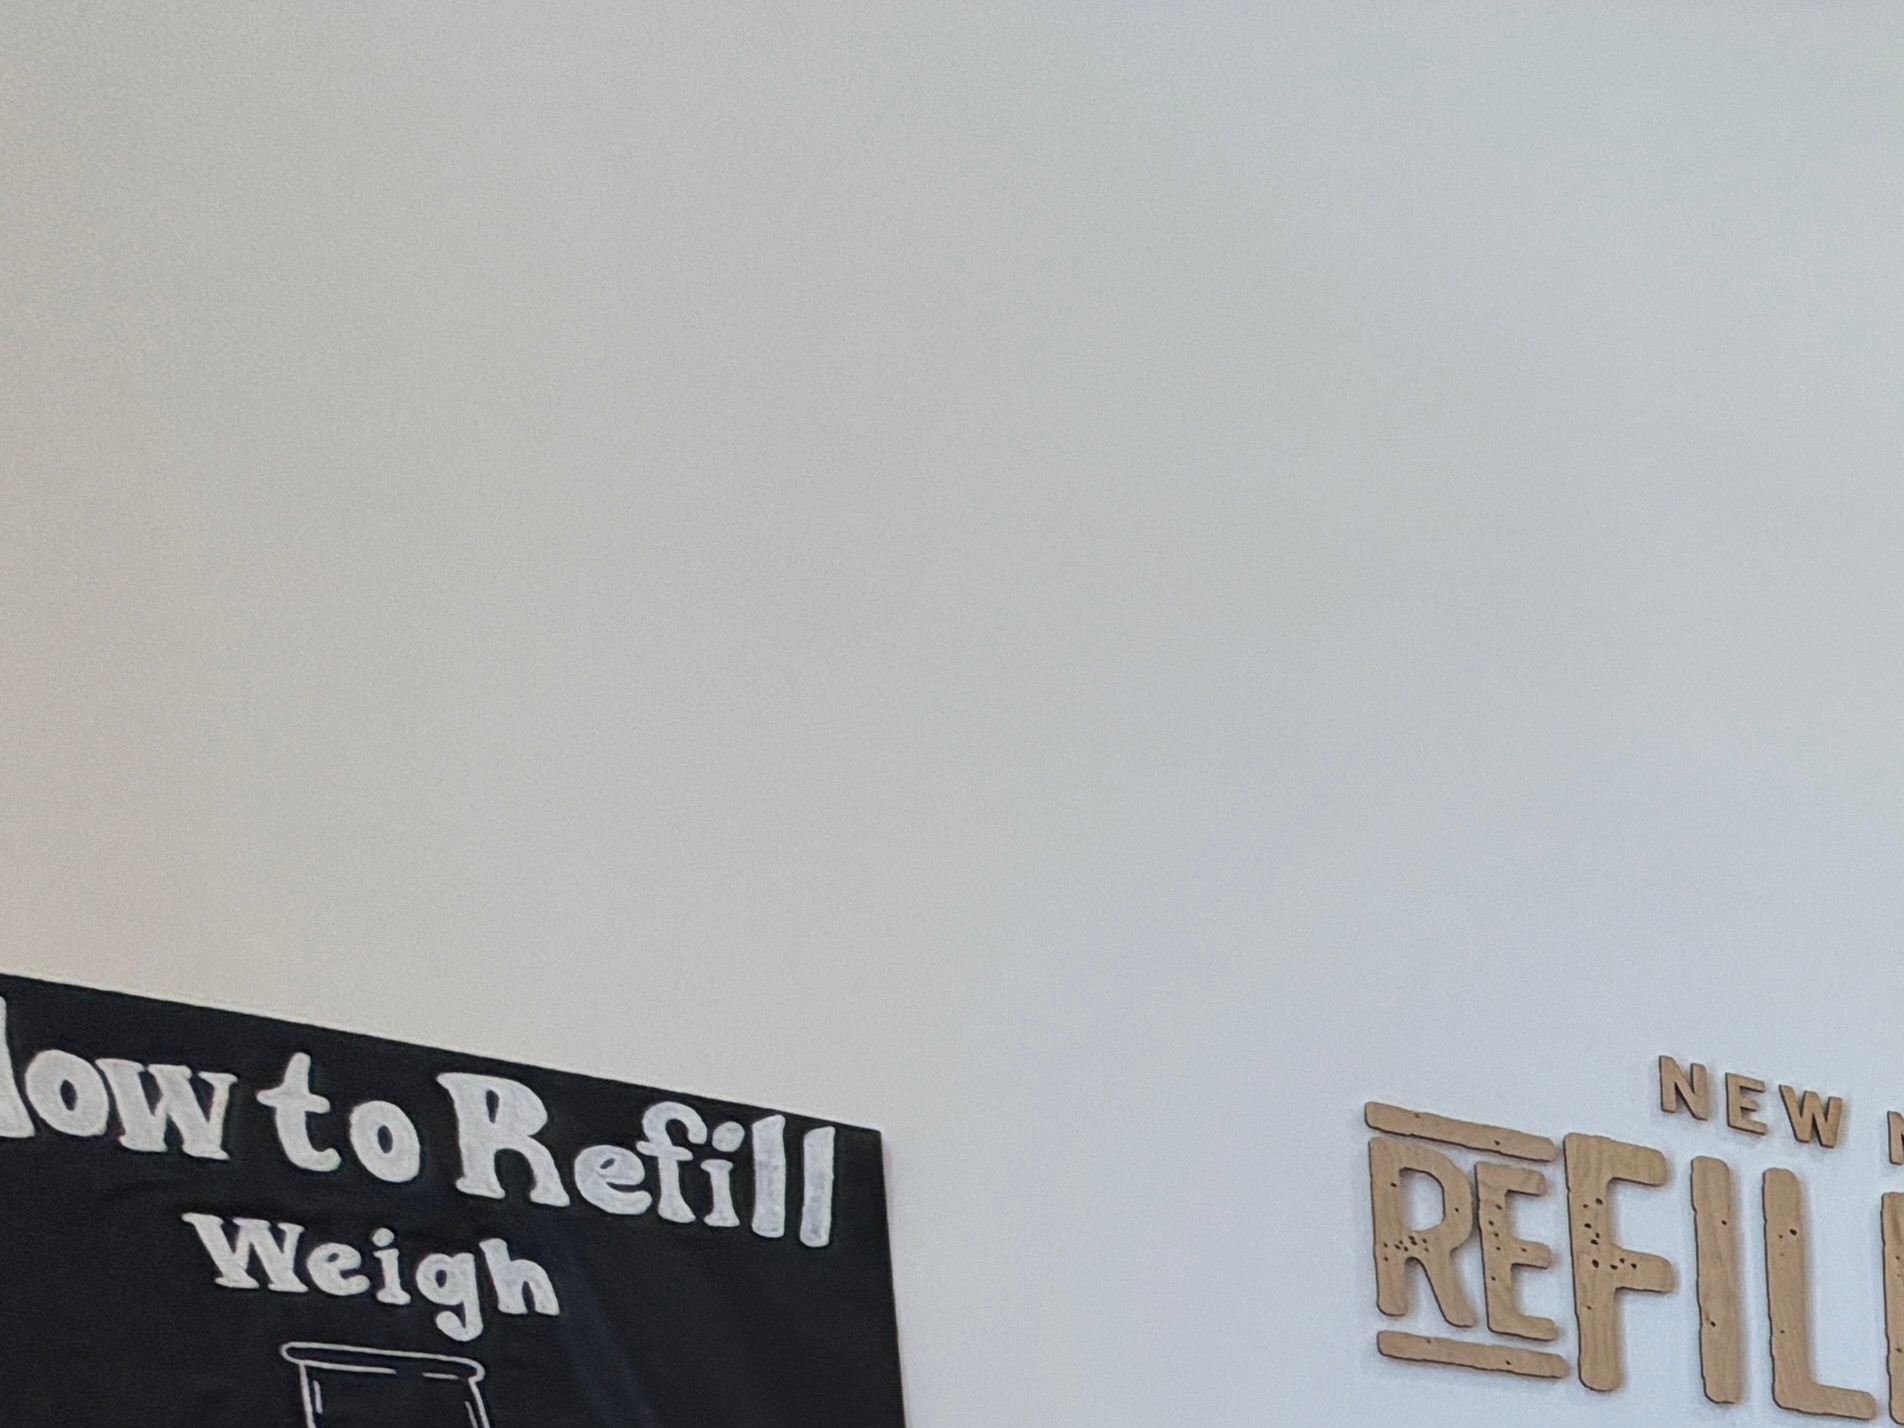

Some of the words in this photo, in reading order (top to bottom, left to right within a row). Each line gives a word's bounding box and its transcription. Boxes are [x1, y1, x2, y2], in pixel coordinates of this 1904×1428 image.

[258, 1053, 420, 1182] to
[437, 1071, 835, 1247] Refill
[1658, 1054, 1844, 1148] NEW
[183, 1212, 560, 1341] Weigh
